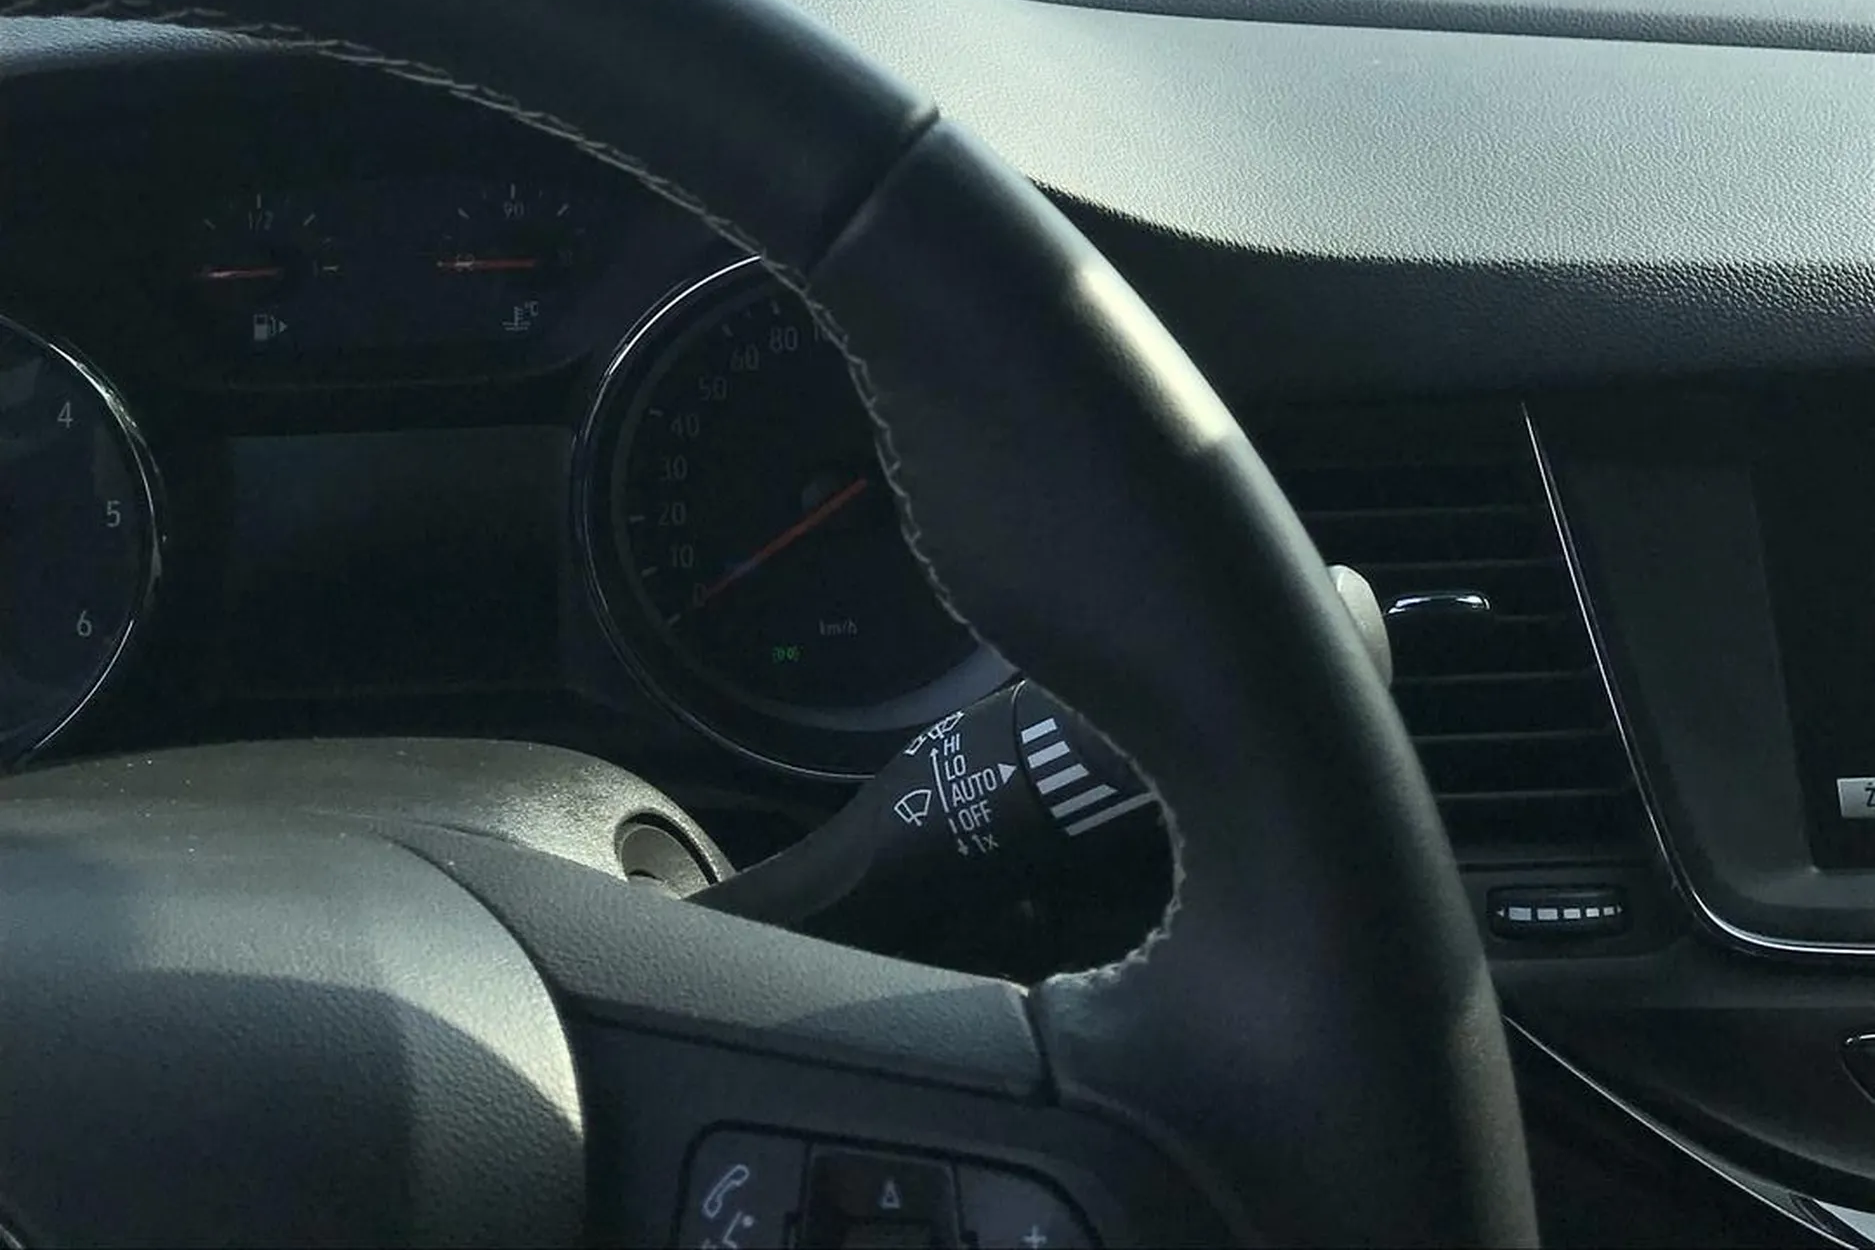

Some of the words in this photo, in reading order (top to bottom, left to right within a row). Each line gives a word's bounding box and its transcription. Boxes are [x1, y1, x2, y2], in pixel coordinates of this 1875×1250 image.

[768, 326, 799, 353] 80
[729, 344, 760, 371] 60
[697, 376, 728, 402] 50
[57, 400, 75, 429] 4
[669, 413, 700, 439] 40
[105, 499, 122, 528] 5
[657, 501, 687, 527] 20
[669, 543, 695, 569] 10
[76, 609, 94, 638] 6
[943, 732, 961, 756] HI
[944, 754, 966, 781] LO
[951, 768, 998, 807] AUTO
[958, 799, 992, 832] OFF
